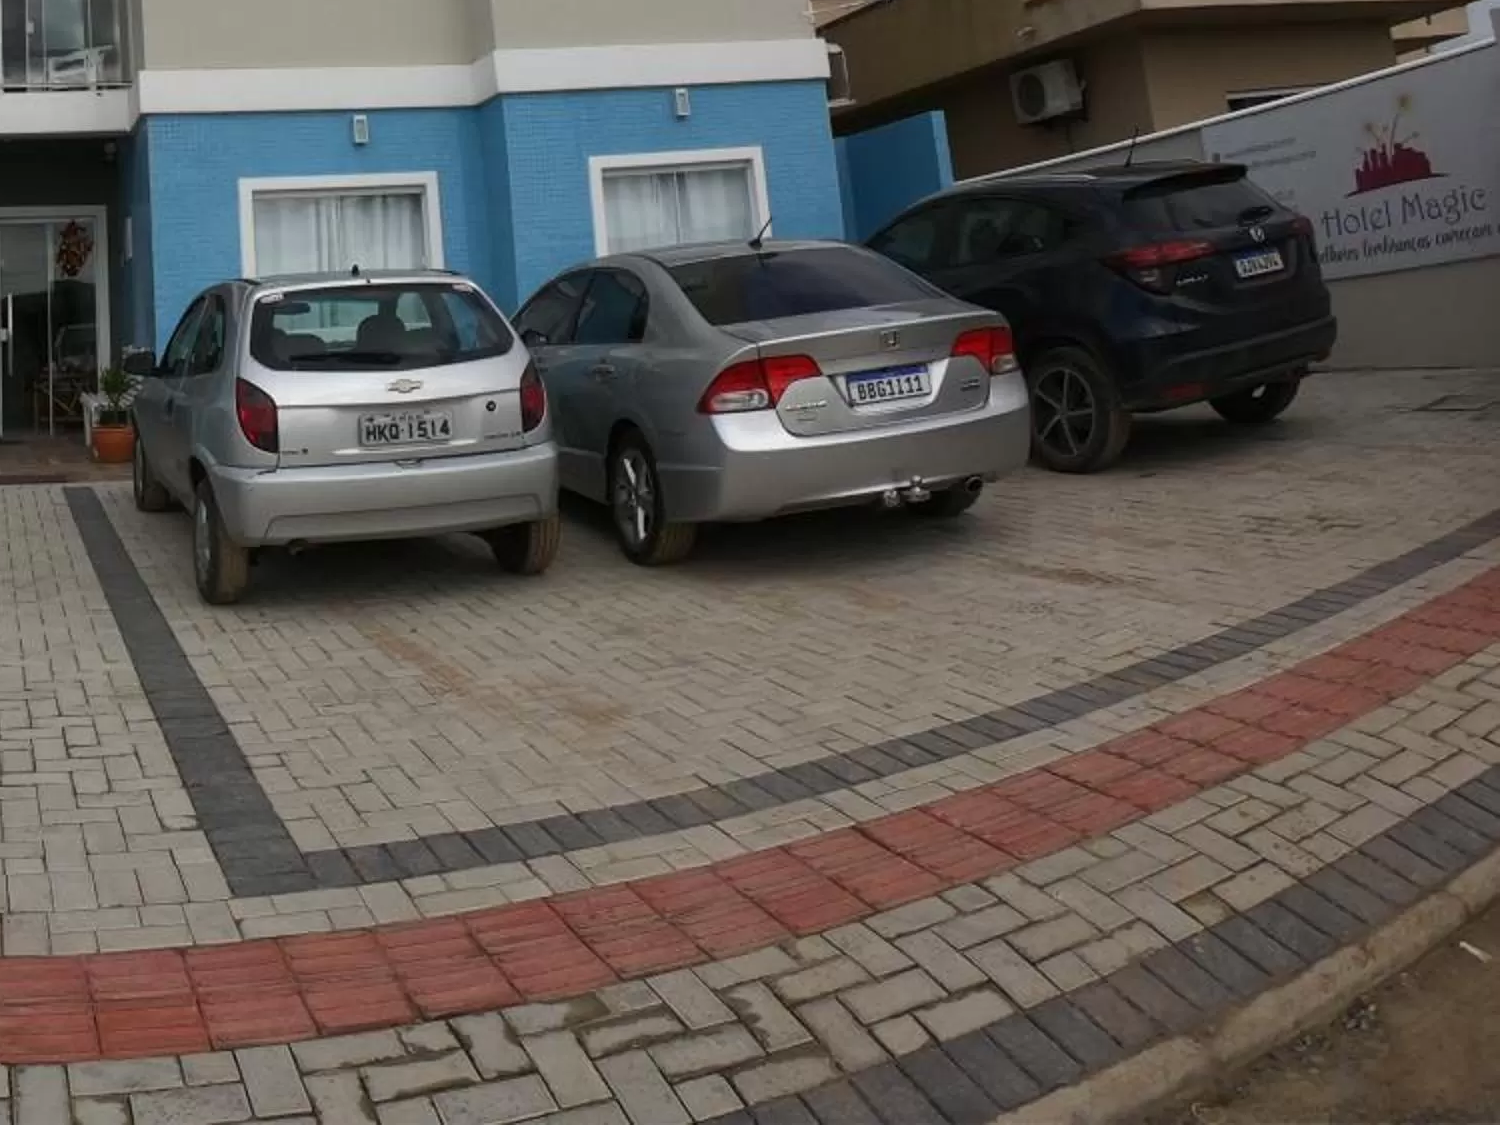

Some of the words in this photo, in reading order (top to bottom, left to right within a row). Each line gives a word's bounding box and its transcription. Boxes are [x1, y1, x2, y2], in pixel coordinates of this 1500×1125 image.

[1321, 200, 1392, 238] Hotel
[1401, 185, 1487, 225] Magic
[856, 374, 925, 401] BBG1111
